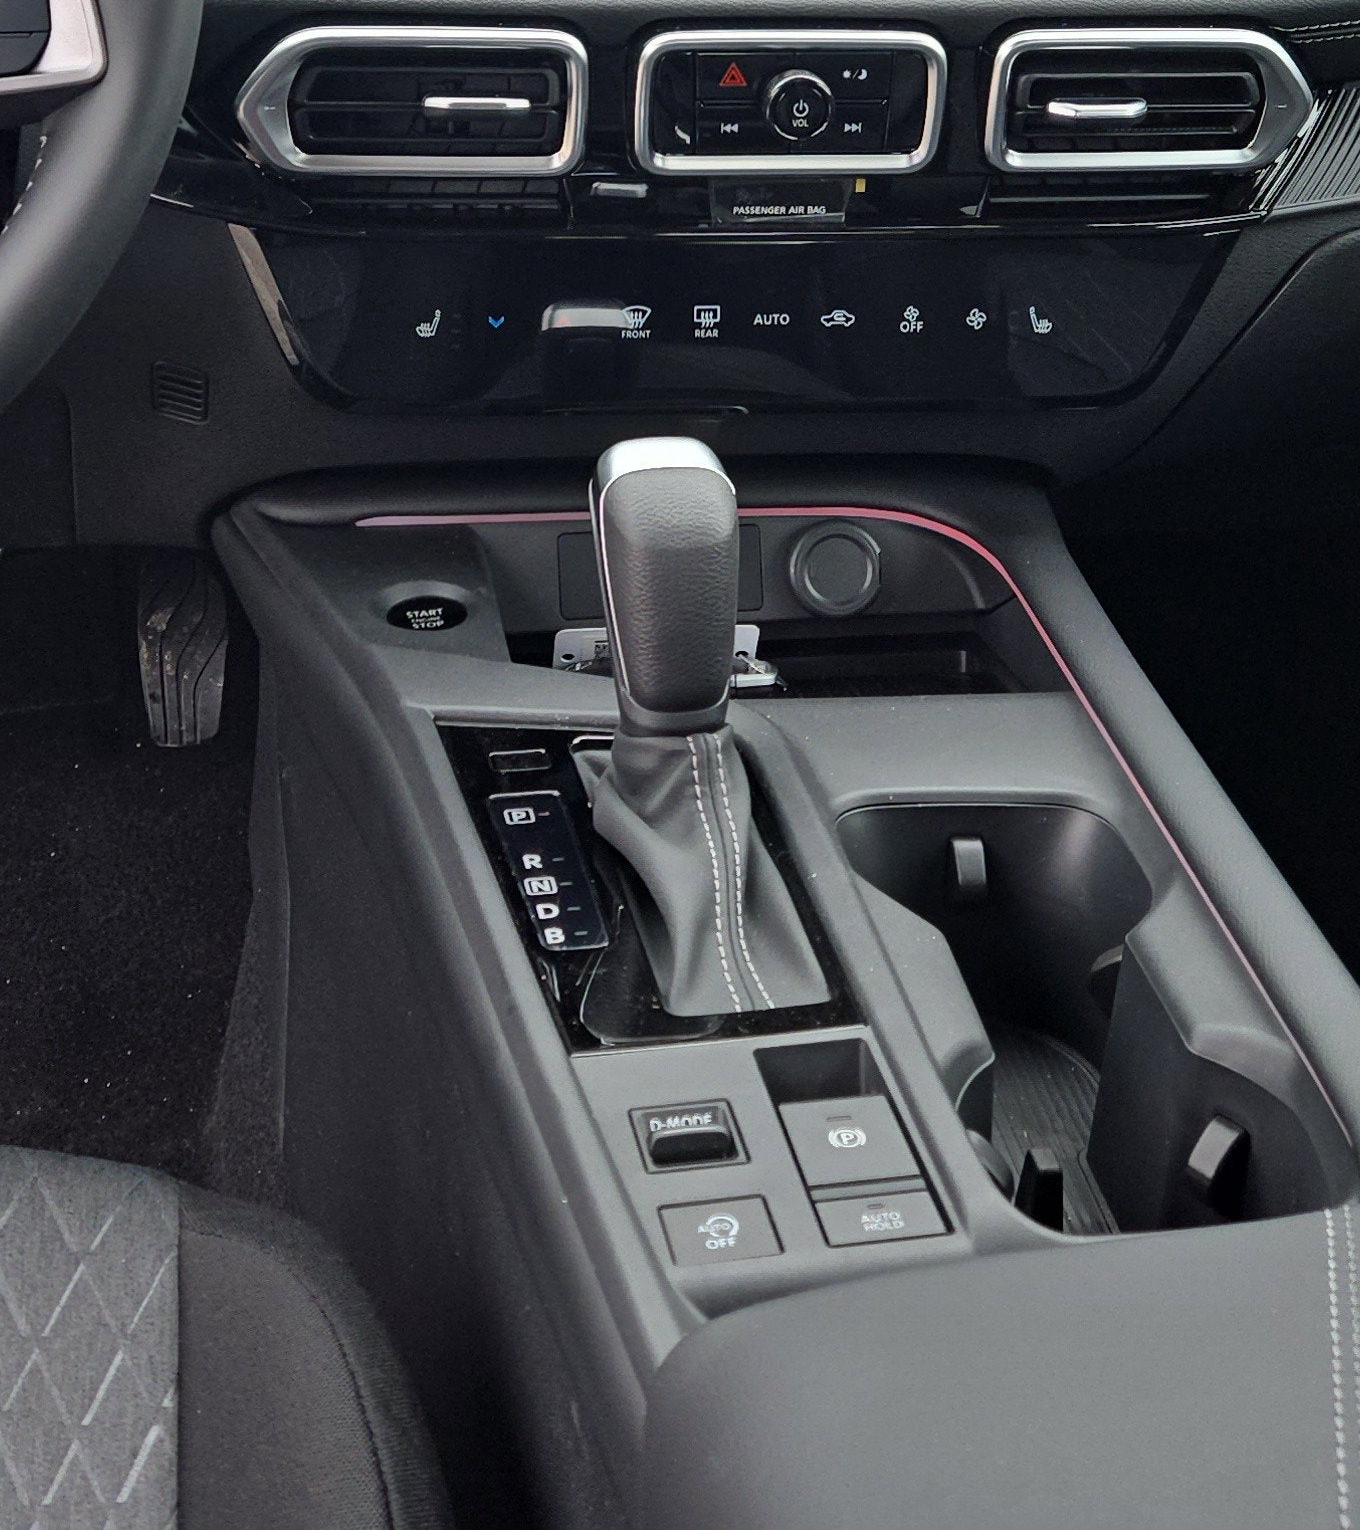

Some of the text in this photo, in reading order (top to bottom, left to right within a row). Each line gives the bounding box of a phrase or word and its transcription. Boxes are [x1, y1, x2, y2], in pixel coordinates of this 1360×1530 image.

[792, 118, 809, 128] VOL
[733, 205, 826, 215] PASSENGER AIR BAG
[753, 313, 790, 325] AUTO
[900, 321, 924, 333] OFF
[622, 329, 651, 339] FRONT
[694, 329, 719, 339] REAR
[406, 608, 443, 619] START
[412, 620, 444, 629] STOP
[521, 854, 543, 870] R
[536, 902, 560, 920] D
[543, 927, 566, 945] B
[649, 1113, 713, 1132] D-MODE
[861, 1211, 901, 1223] AUTO
[705, 1237, 737, 1250] OFF
